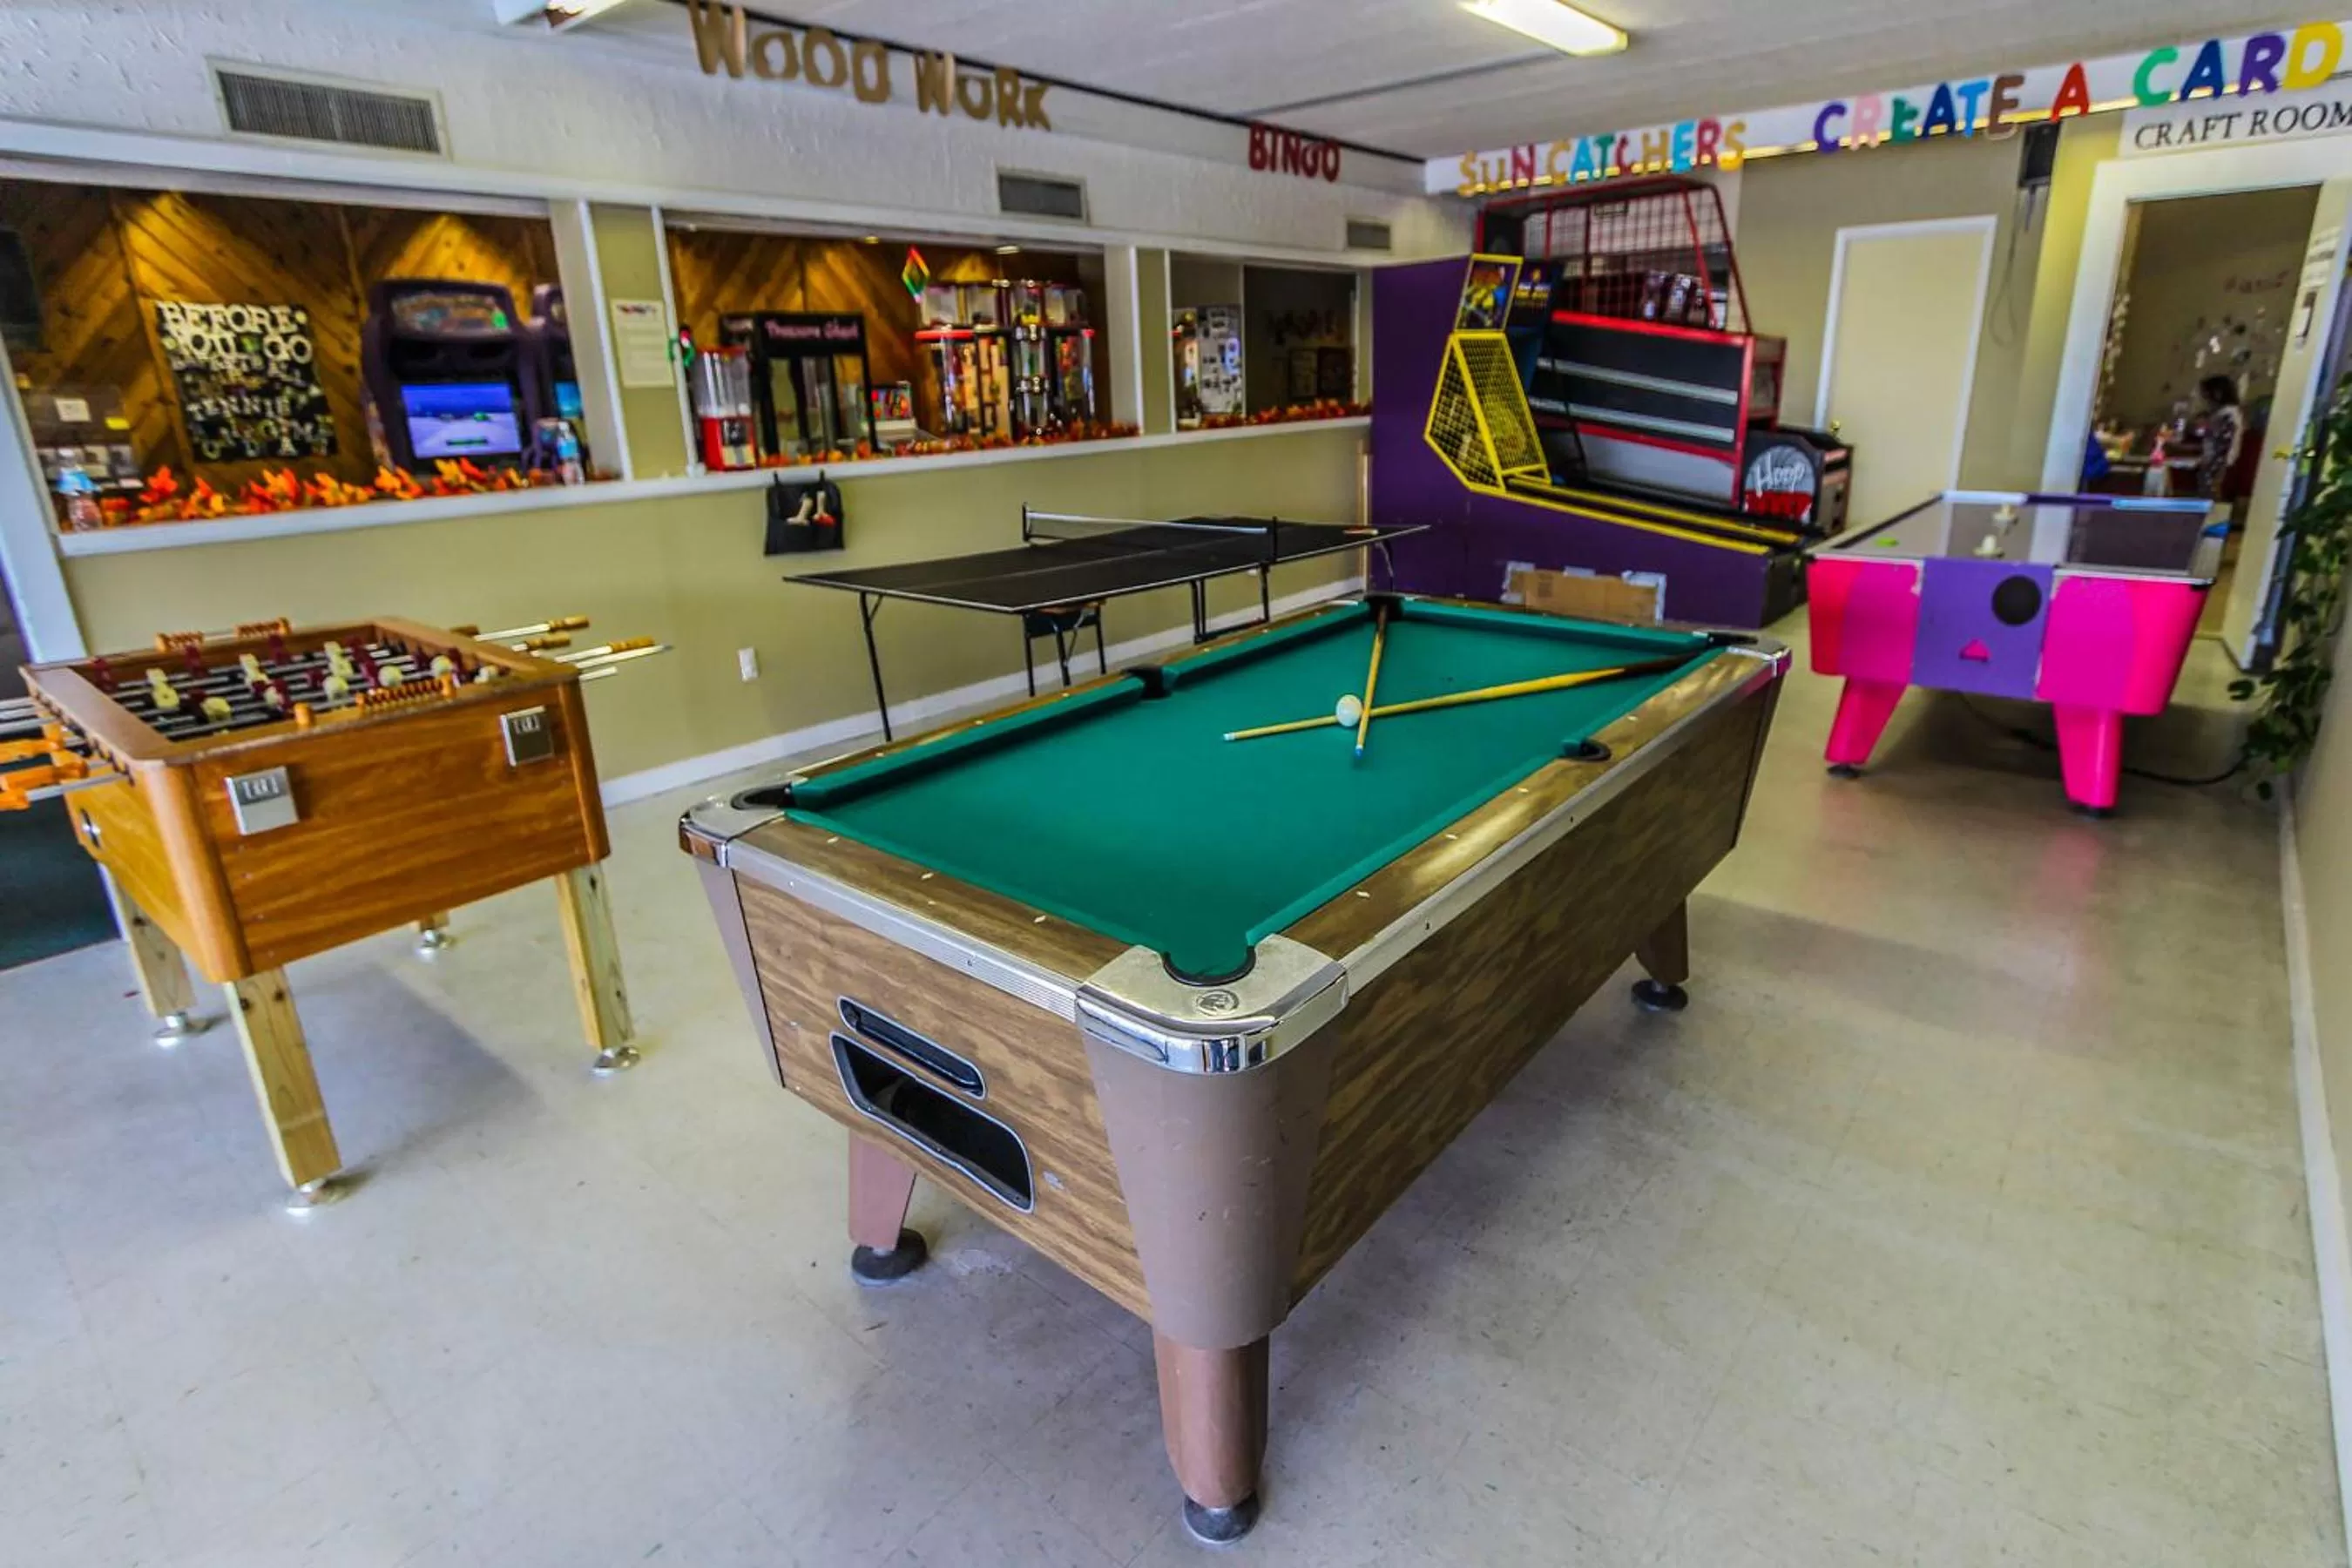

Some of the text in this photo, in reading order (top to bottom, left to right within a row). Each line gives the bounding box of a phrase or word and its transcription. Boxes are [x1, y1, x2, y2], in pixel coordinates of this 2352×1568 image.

[688, 0, 1051, 132] WOOD WORK
[1814, 20, 2344, 153] CREATE A CARD
[1248, 120, 1341, 183] BINGO
[1456, 117, 1747, 198] SUN CATCHERS
[2134, 101, 2352, 151] CRAFT ROOM
[159, 302, 300, 334] BEFORE
